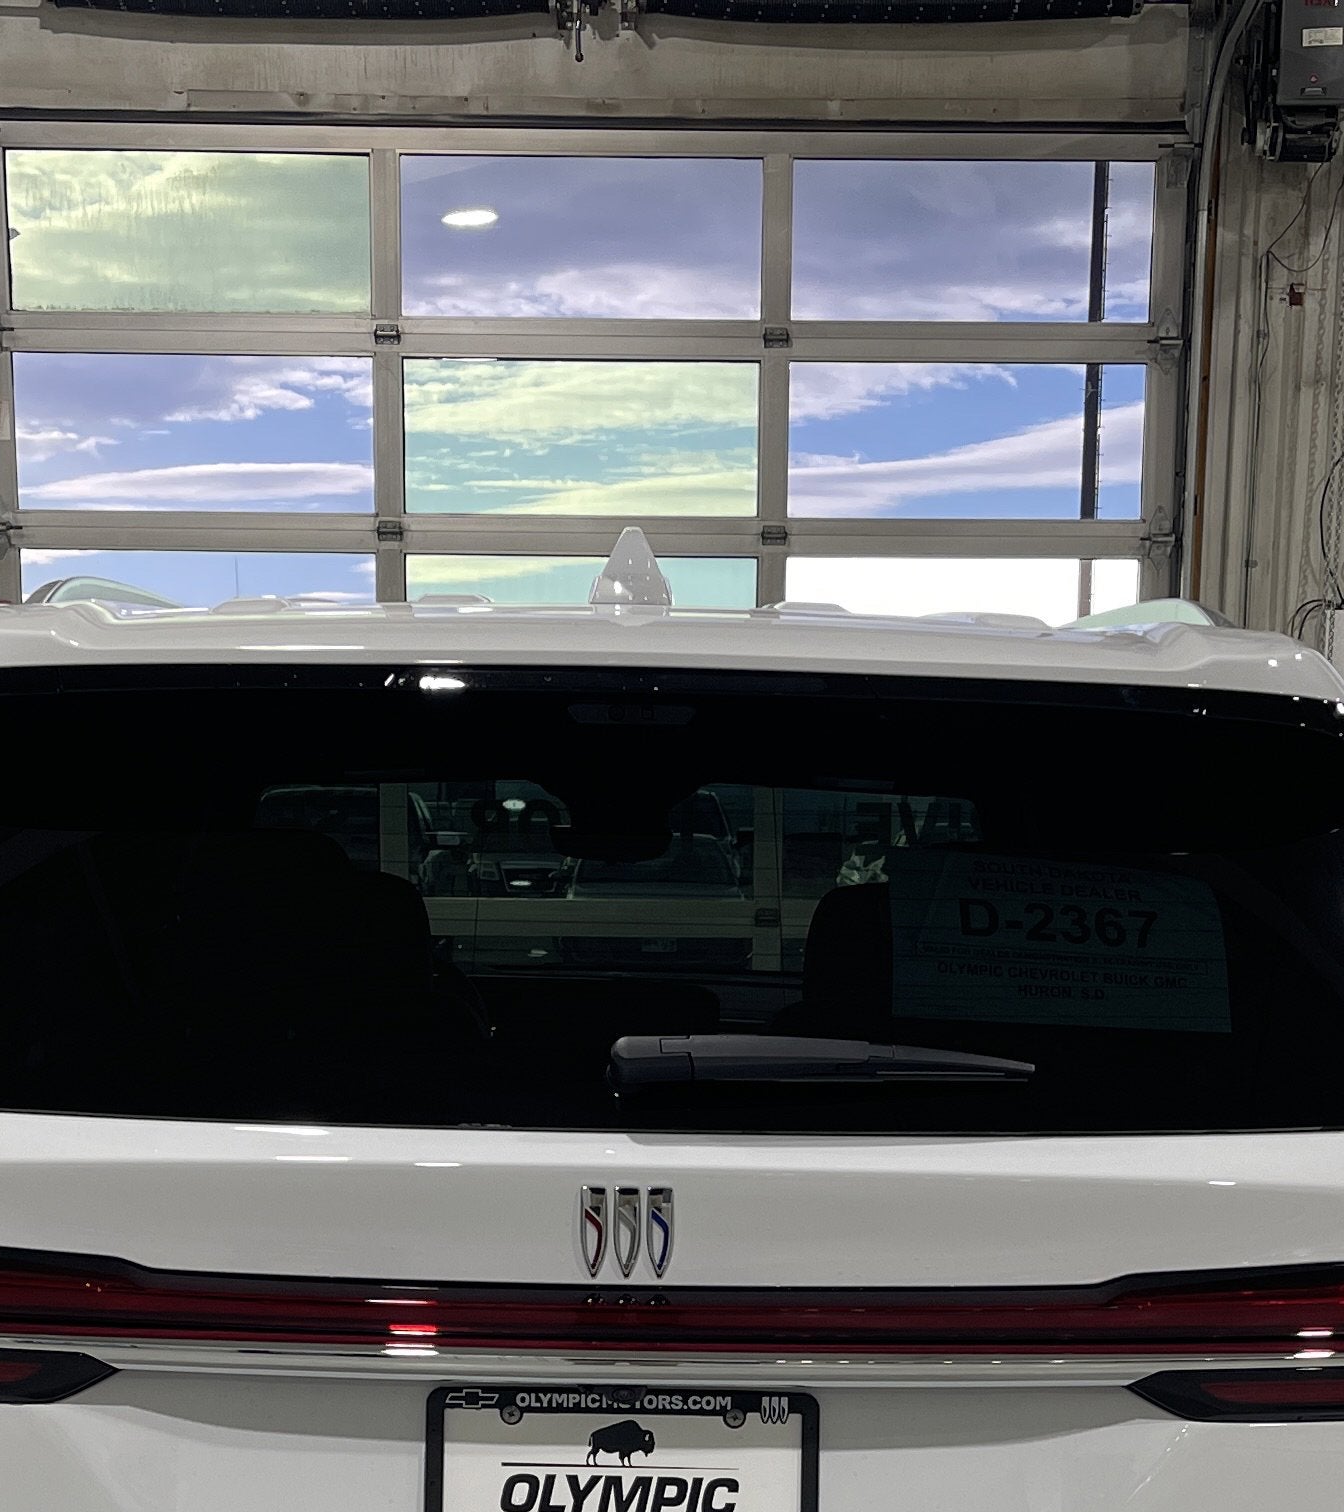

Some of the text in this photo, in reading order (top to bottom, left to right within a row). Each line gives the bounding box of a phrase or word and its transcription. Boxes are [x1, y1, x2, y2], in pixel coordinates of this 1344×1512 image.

[968, 875, 1142, 903] VEHICLE DEALER
[958, 897, 1158, 949] D-2367
[937, 961, 1004, 978] OLYMPIC
[1008, 964, 1099, 983] CHEVROLET
[1103, 972, 1148, 987] BUICK
[1153, 975, 1187, 989] GMC
